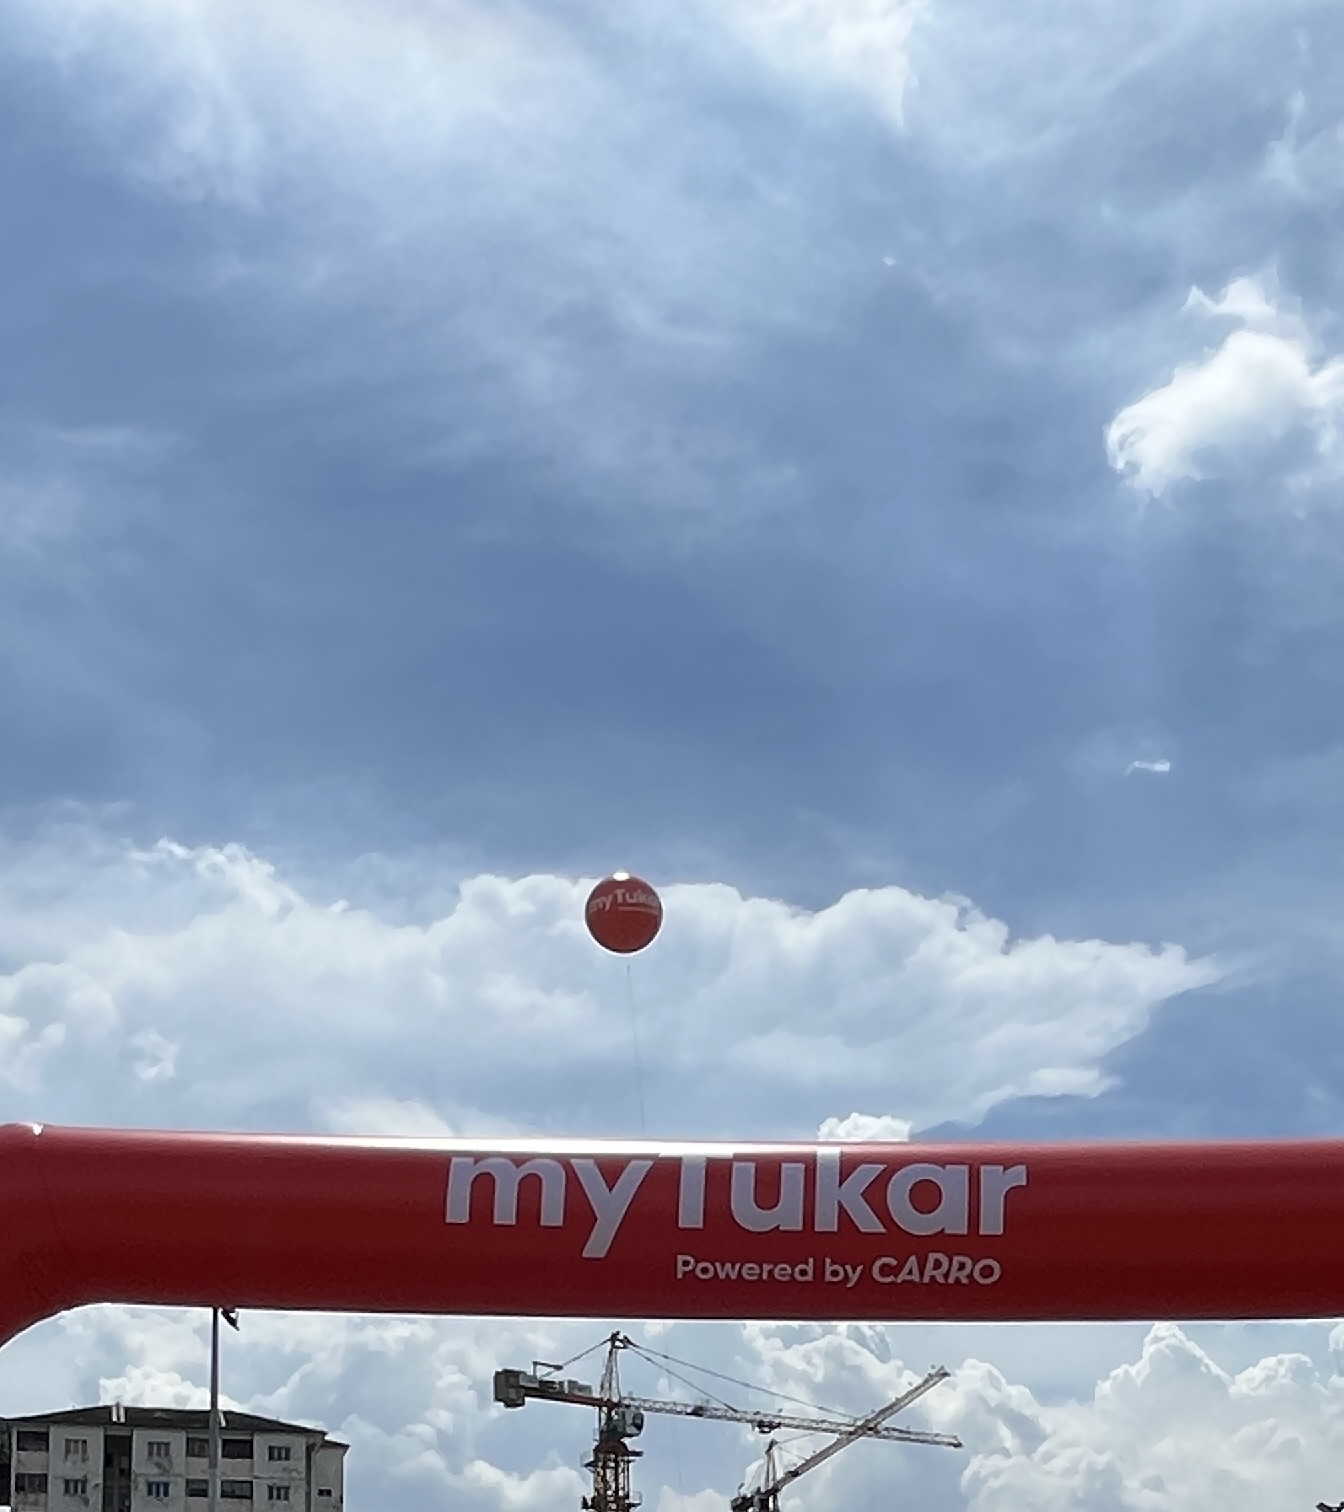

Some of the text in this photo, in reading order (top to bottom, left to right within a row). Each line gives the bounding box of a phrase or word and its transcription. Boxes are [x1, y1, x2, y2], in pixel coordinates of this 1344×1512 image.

[445, 1147, 1028, 1258] myTukar
[676, 1252, 1002, 1288] Powered by CARRO
